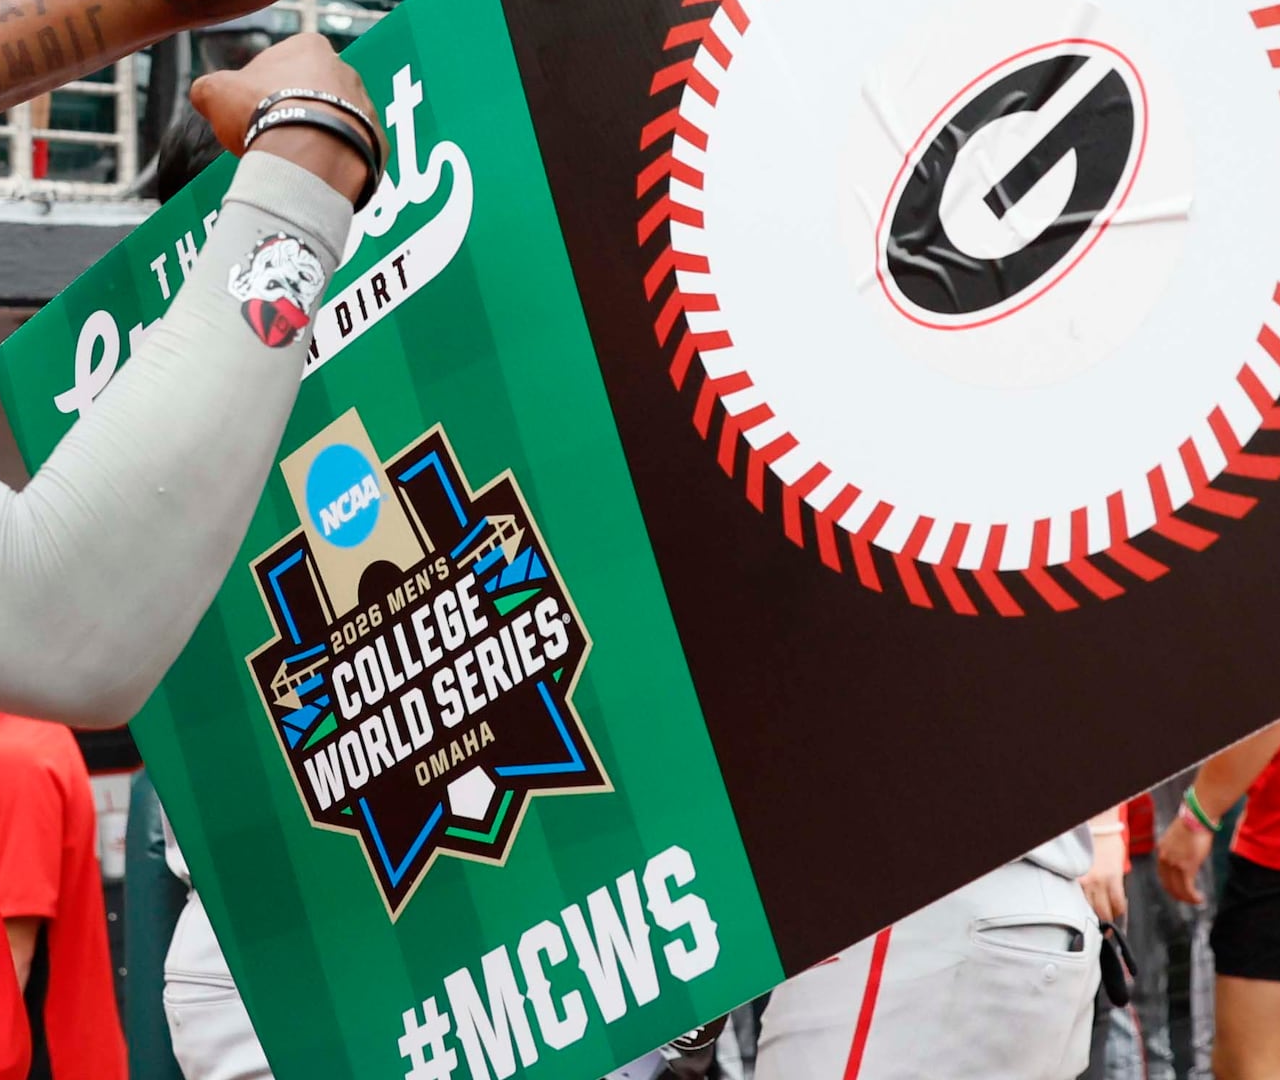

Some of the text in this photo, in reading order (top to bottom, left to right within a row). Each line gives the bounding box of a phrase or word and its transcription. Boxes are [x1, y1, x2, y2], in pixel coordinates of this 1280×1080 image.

[258, 107, 306, 130] FOUR
[887, 54, 1134, 314] G
[334, 254, 410, 338] DIRT
[319, 474, 381, 537] NCAA
[330, 557, 451, 655] 2026 MEN'S
[331, 572, 489, 720] COLLEGE
[303, 596, 570, 812] WORLD SERIES
[414, 722, 496, 787] OMAHA
[398, 845, 720, 1080] #MCWS
